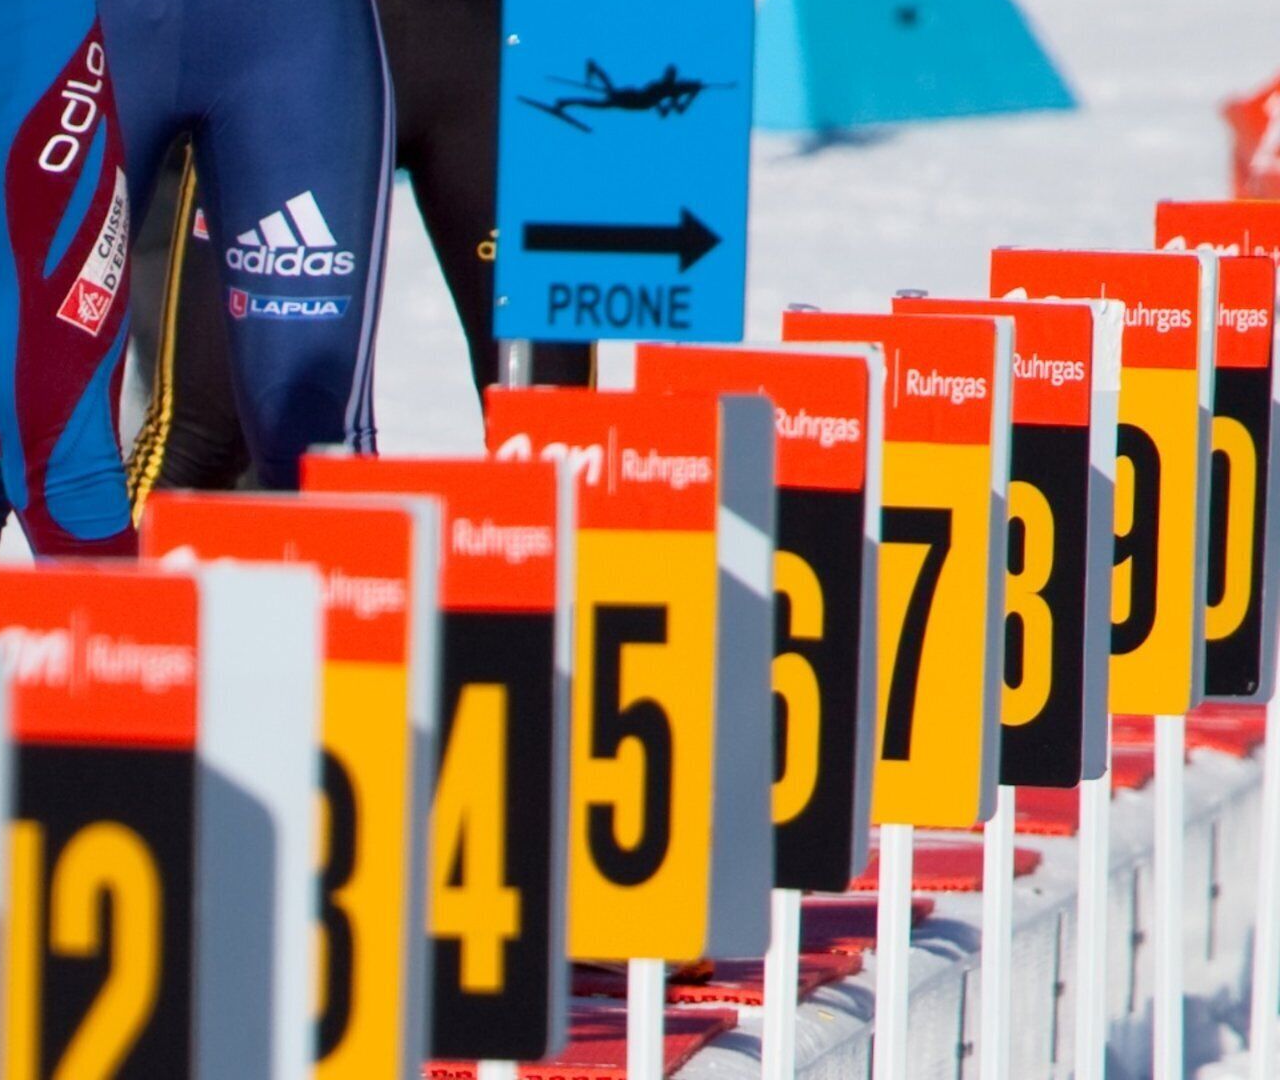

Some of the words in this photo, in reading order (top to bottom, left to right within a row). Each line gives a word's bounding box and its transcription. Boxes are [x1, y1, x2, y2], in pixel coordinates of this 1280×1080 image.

[38, 42, 105, 172] odlo
[98, 196, 124, 259] CAISSE
[225, 245, 355, 277] adidas
[250, 298, 340, 316] LAPUA
[547, 282, 692, 330] PRONE
[1124, 301, 1192, 333] uhrgas
[1219, 302, 1269, 333] hrgas
[906, 368, 987, 405] Ruhrgas
[621, 448, 713, 490] Ruhrgas
[880, 506, 952, 762] 7
[587, 603, 673, 888] 5
[426, 682, 521, 993] 4
